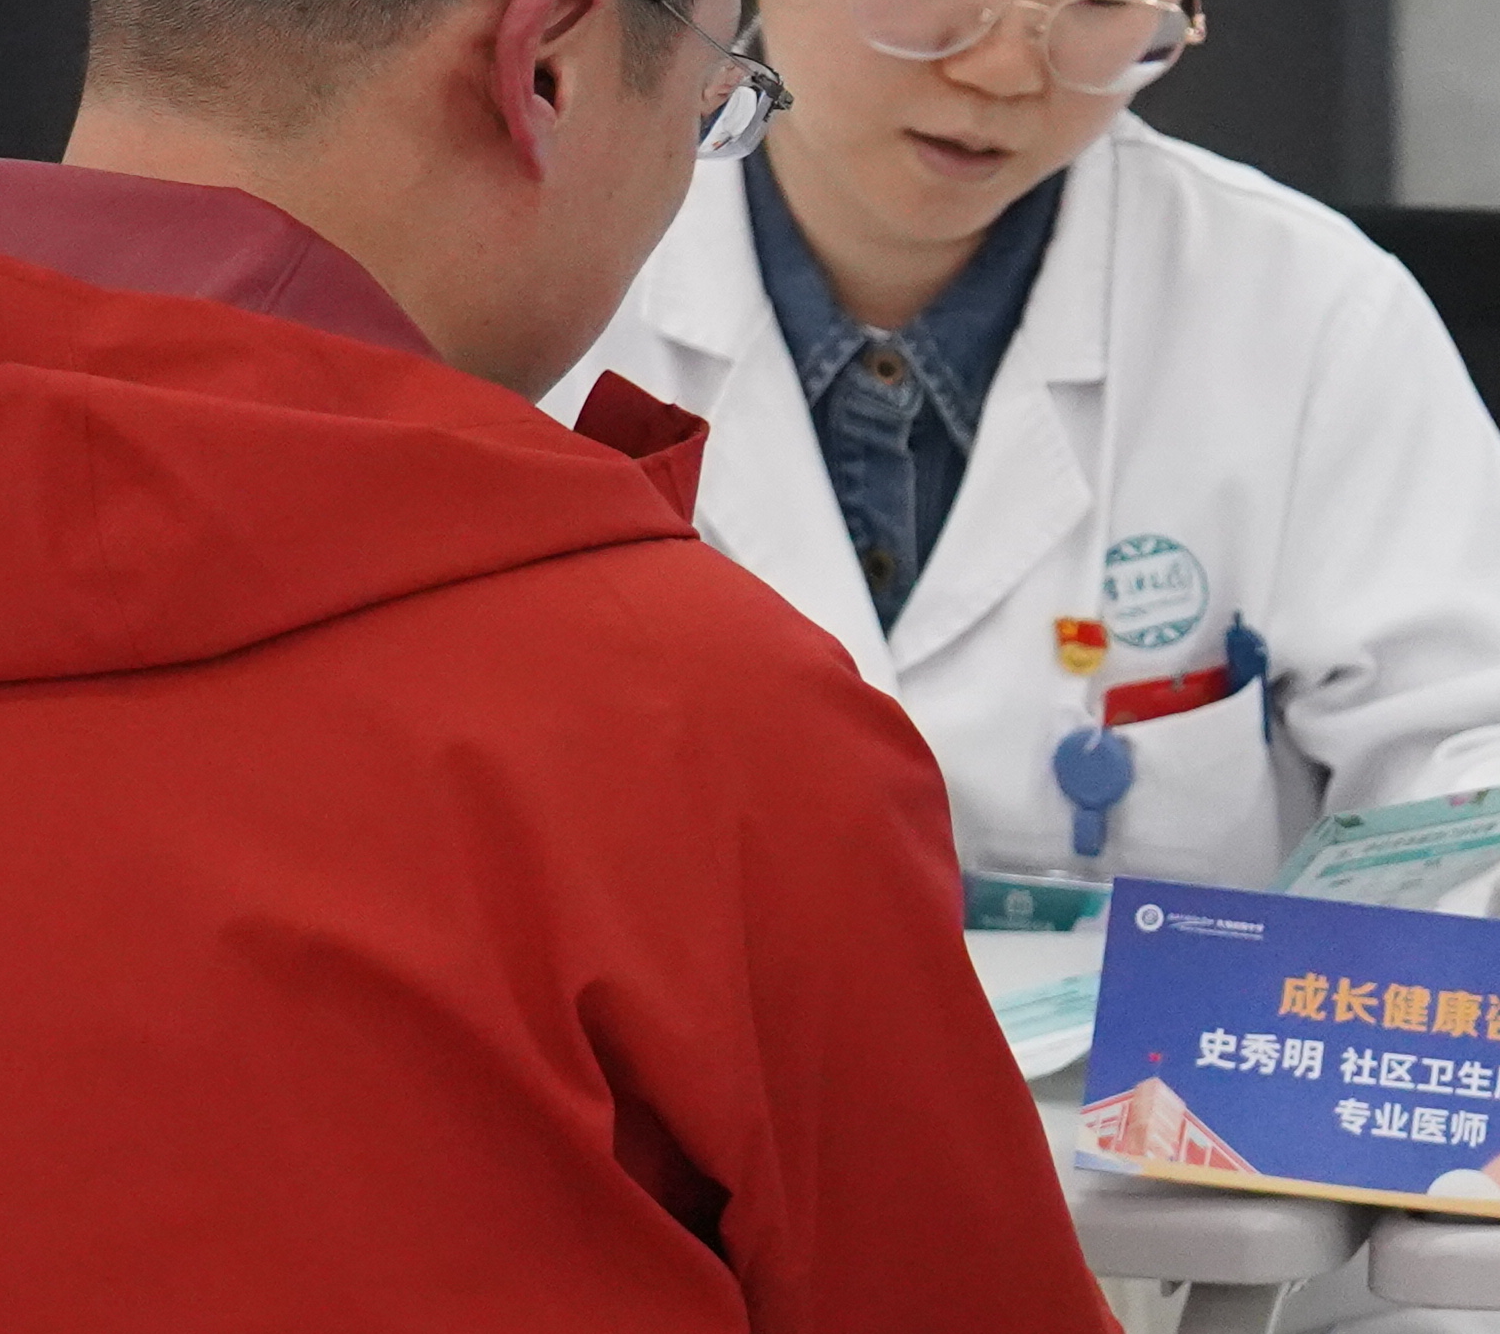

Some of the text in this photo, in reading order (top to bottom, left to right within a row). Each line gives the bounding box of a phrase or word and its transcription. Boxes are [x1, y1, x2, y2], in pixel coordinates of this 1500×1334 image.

[1195, 1028, 1325, 1081] 史秀明
[1334, 1097, 1489, 1148] 专业医师
